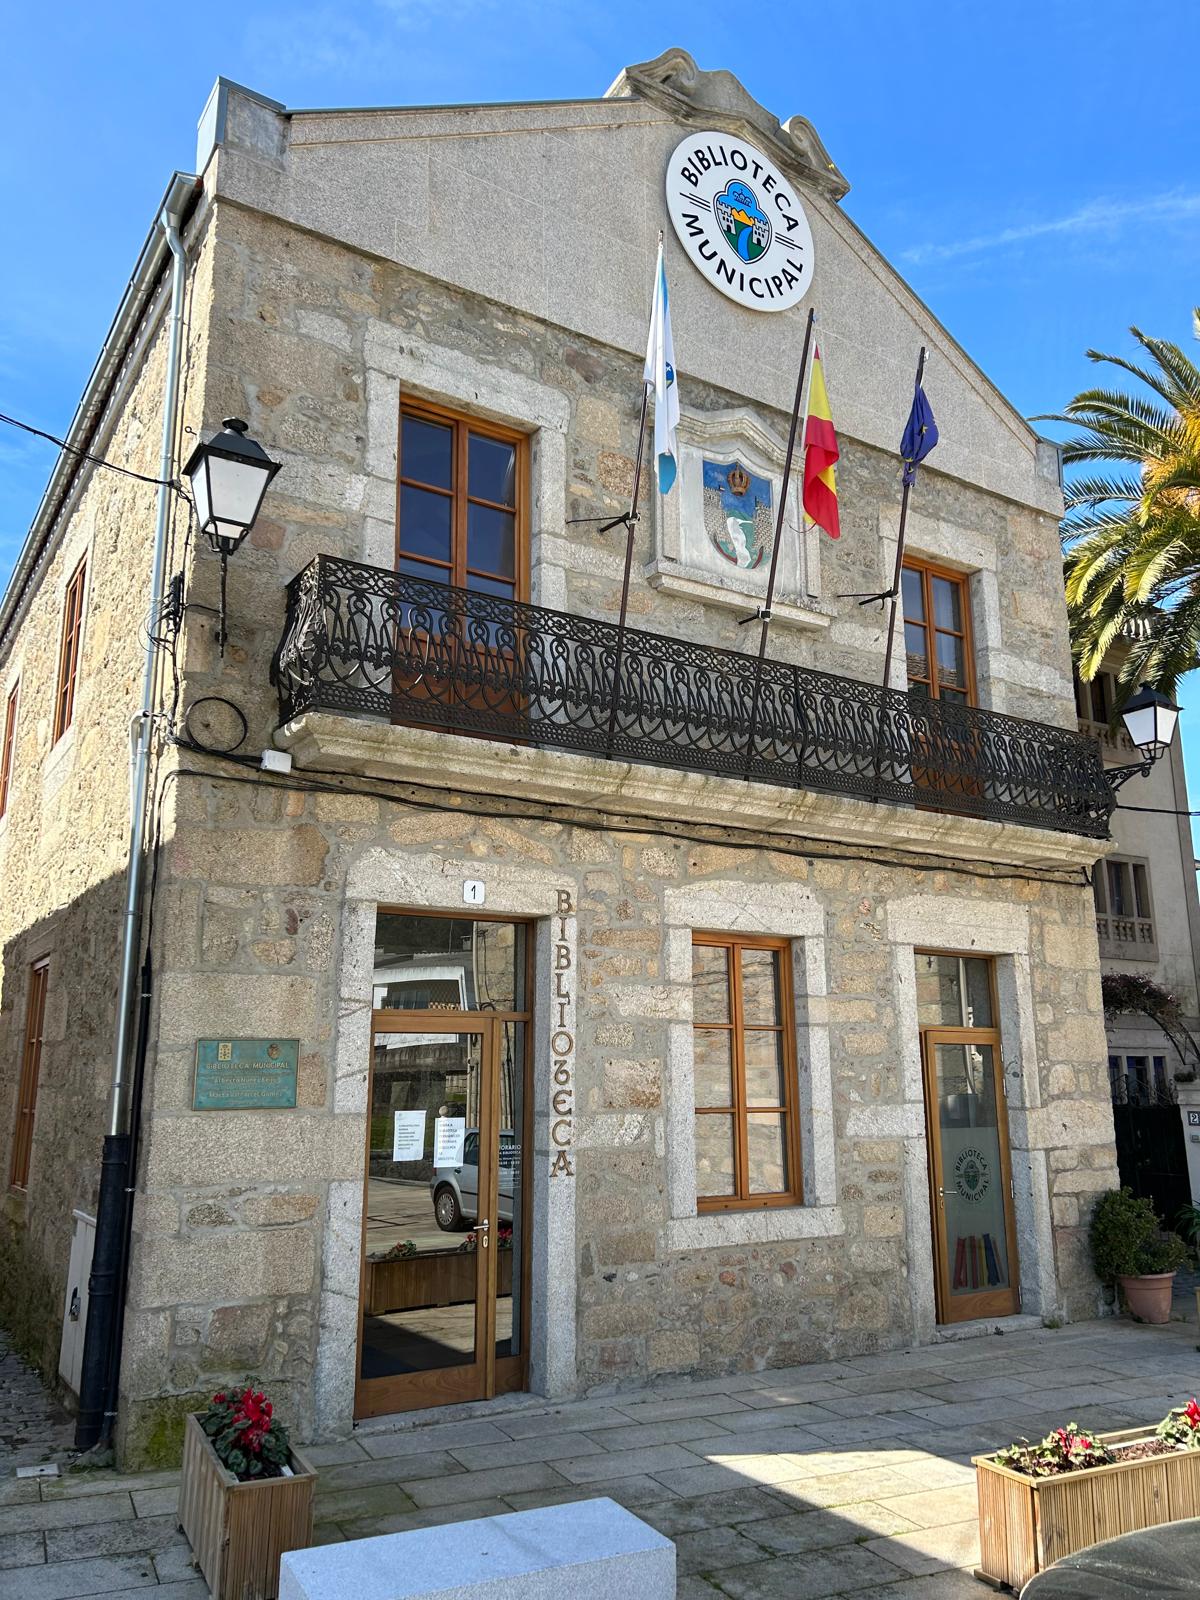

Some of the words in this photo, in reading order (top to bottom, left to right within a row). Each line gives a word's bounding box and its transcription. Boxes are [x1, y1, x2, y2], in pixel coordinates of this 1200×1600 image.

[680, 145, 799, 232] BIBLIOTECA
[681, 213, 804, 298] MUNICIPAL
[471, 885, 476, 899] 1
[550, 889, 574, 1178] BIBLIOTECA
[956, 1149, 988, 1172] BIBLIOTECA
[956, 1180, 989, 1202] MUNICIPAL
